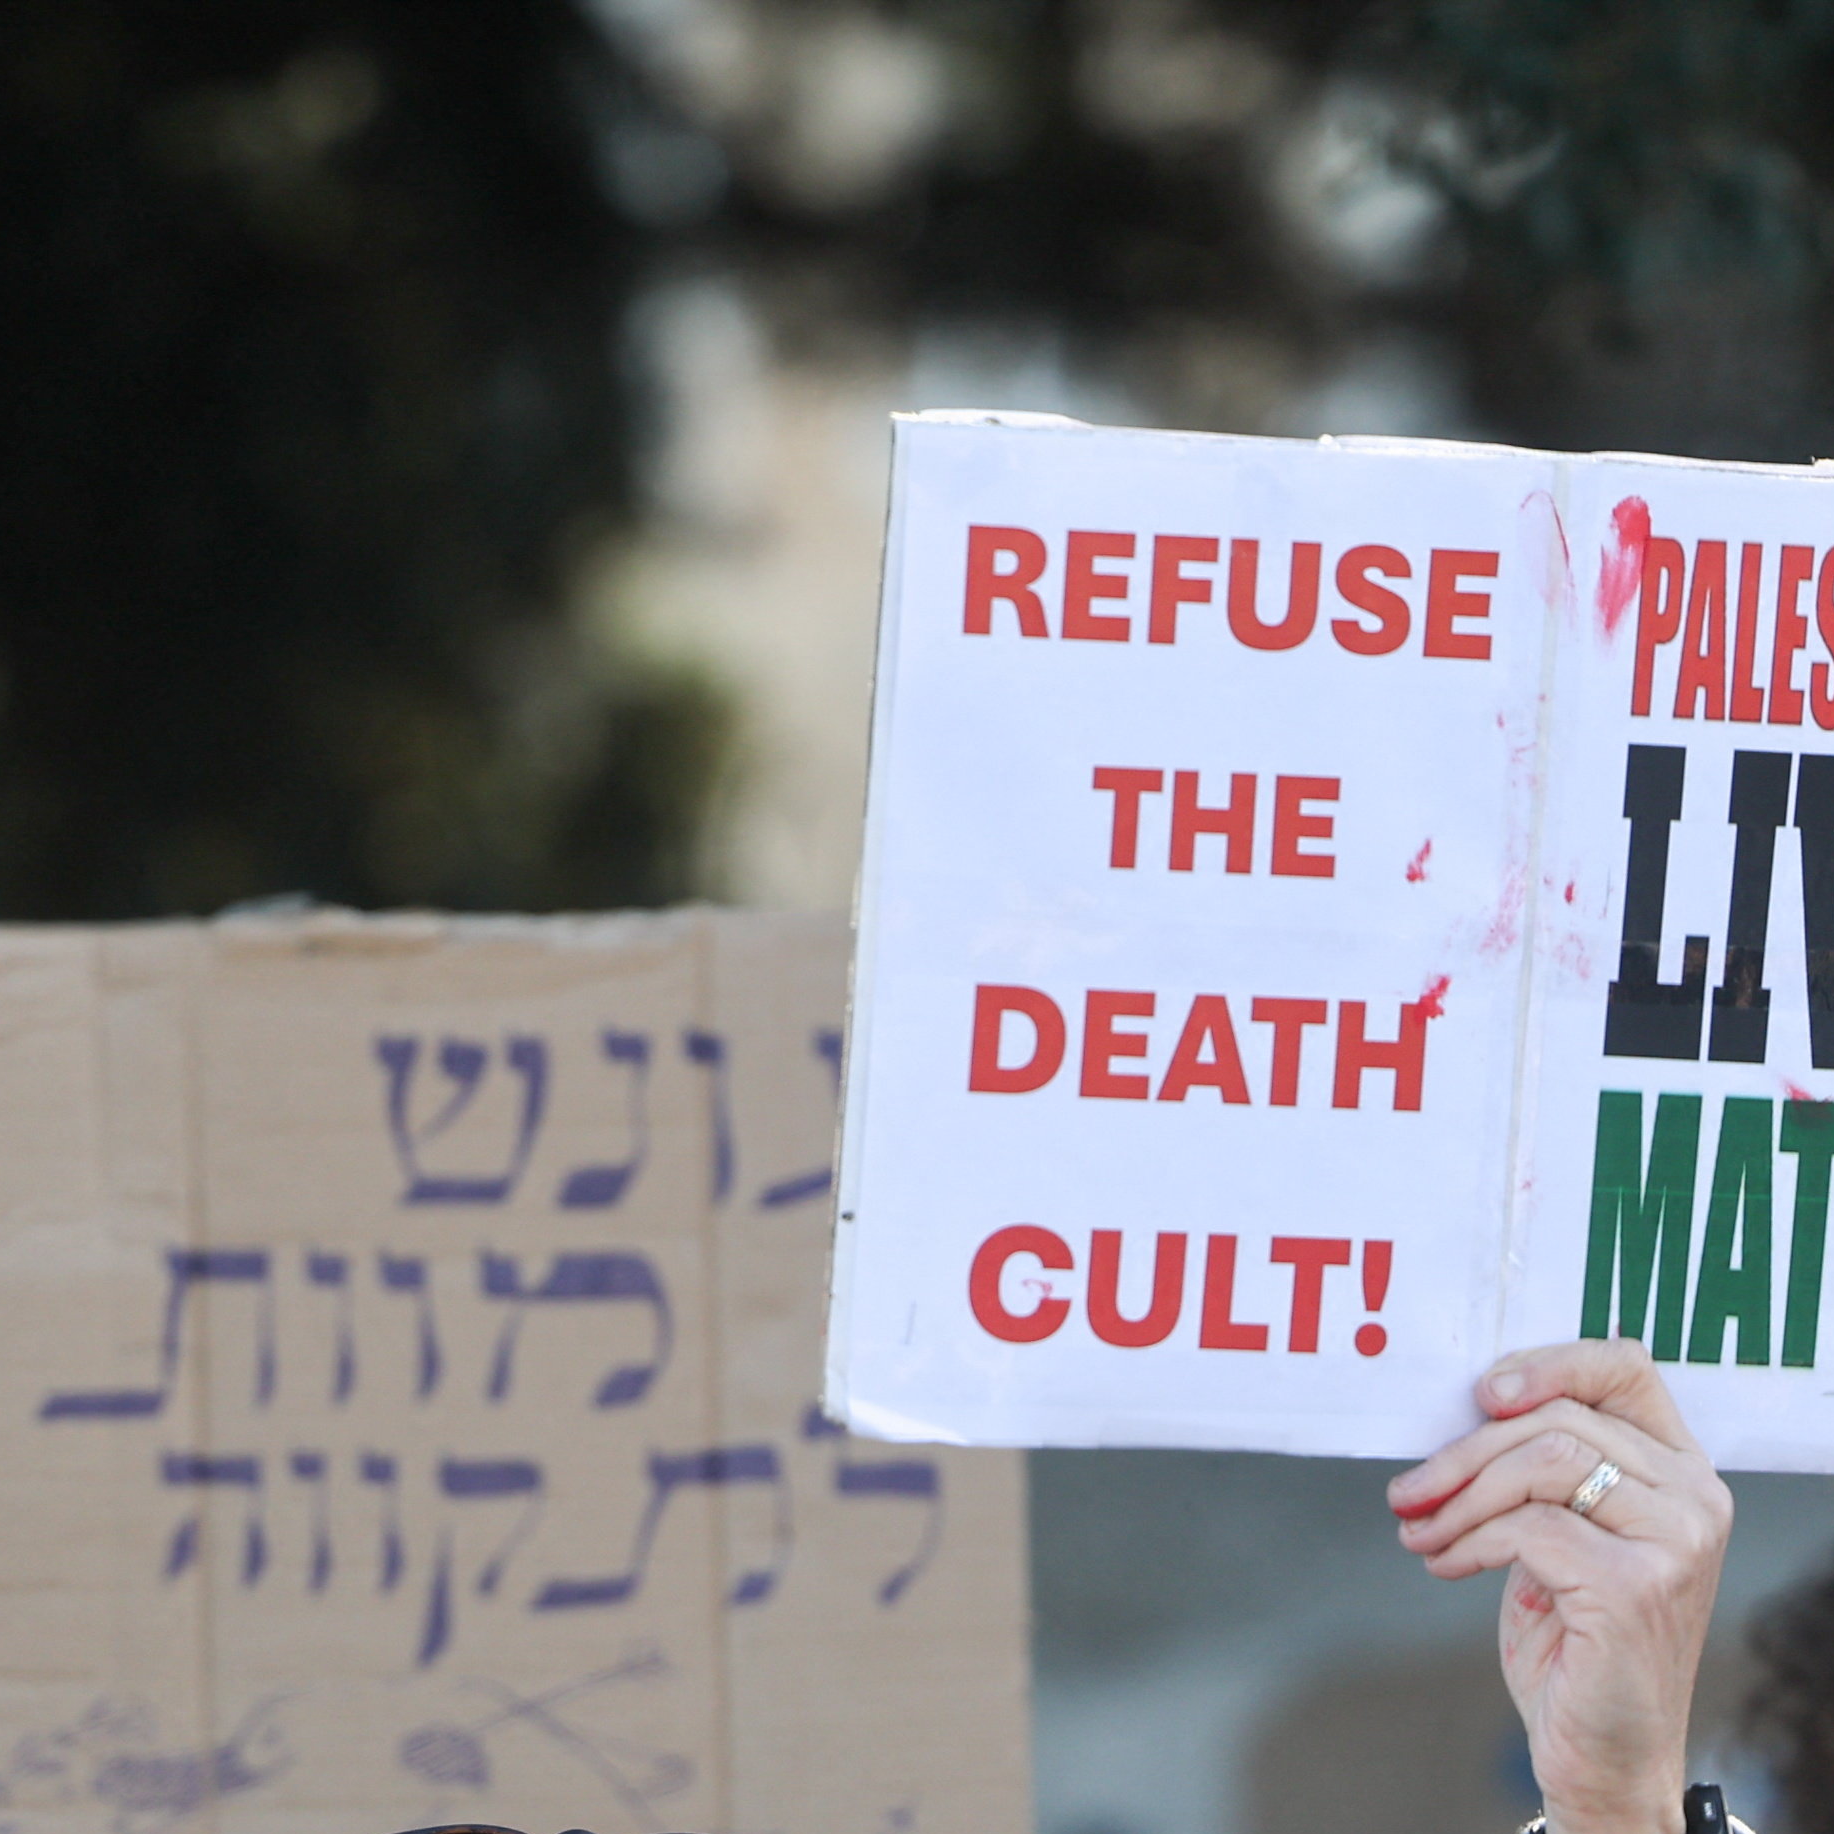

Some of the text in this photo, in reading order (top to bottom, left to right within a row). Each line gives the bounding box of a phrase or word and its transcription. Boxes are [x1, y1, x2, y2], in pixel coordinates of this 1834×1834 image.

[964, 525, 1500, 660] REFUSE
[1093, 767, 1341, 878] THE
[969, 984, 1425, 1112] DEATH
[38, 1248, 672, 1422] מוות
[970, 1225, 1392, 1358] CULT!
